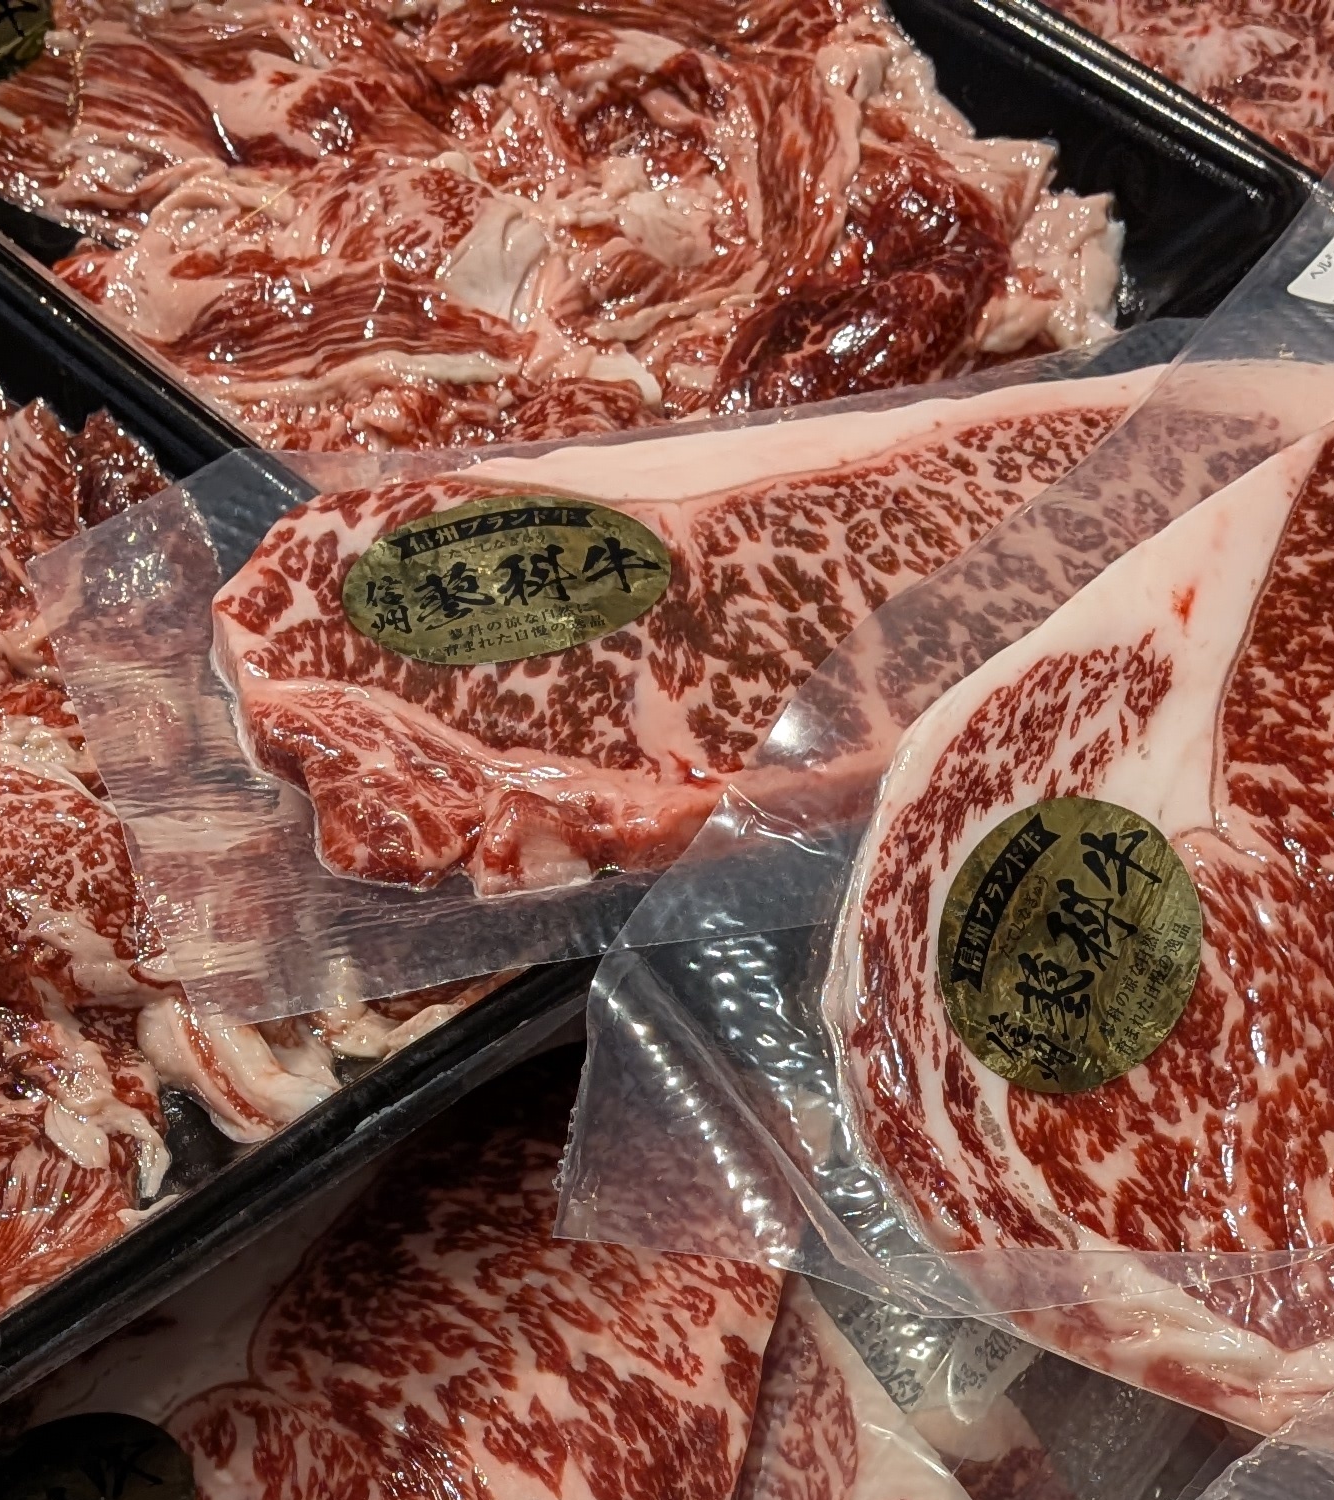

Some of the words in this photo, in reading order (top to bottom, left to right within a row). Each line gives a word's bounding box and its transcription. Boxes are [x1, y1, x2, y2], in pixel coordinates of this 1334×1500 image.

[408, 509, 578, 551] 信州ブランド牛
[959, 831, 1042, 972] 信州ブランド牛
